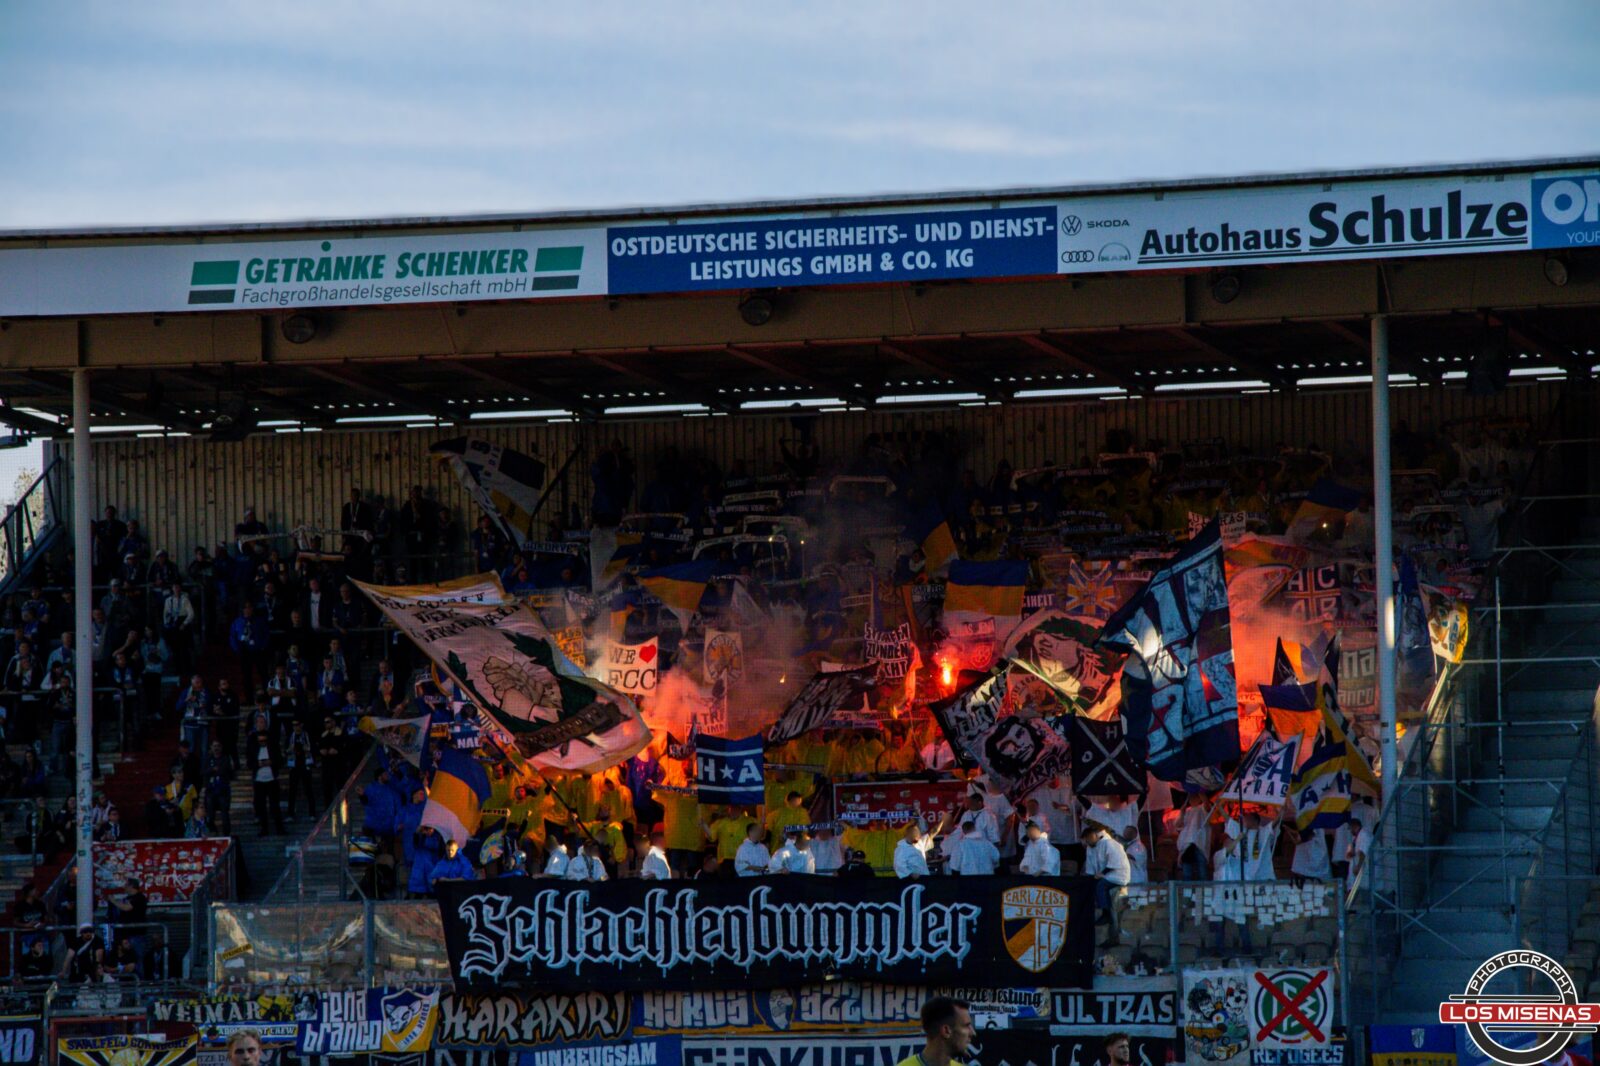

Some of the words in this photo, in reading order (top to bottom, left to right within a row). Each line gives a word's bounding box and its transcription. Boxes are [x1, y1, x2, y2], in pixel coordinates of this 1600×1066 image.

[611, 231, 758, 258] OSTDEUTSCHE
[764, 225, 908, 251] SICHERHEITS-
[914, 221, 963, 244] UND
[970, 217, 1055, 241] DIENST-
[1140, 222, 1302, 256] Autohaus
[1308, 190, 1528, 248] Schulze
[396, 248, 529, 279] SCHENKER
[690, 257, 804, 281] LEISTUNGS
[810, 252, 873, 275] GMBH
[879, 253, 895, 272] &
[901, 250, 938, 271] CO.
[945, 248, 975, 268] KG
[241, 278, 481, 306] Fachgroßhandelsgesellschaft
[487, 276, 527, 294] mbH
[609, 647, 636, 664] WE
[608, 668, 656, 690] FCC
[1005, 889, 1034, 905] CARL
[1034, 889, 1065, 905] ZEISS
[1015, 906, 1055, 918] JENA
[458, 884, 982, 977] Schlachtenbummler
[154, 1000, 264, 1024] WEIMAR
[441, 991, 625, 1042] HARAKIRI
[1055, 993, 1174, 1024] ULTRAS
[534, 1041, 657, 1066] UNBEUGSAM
[1253, 1045, 1346, 1065] REFUGEES
